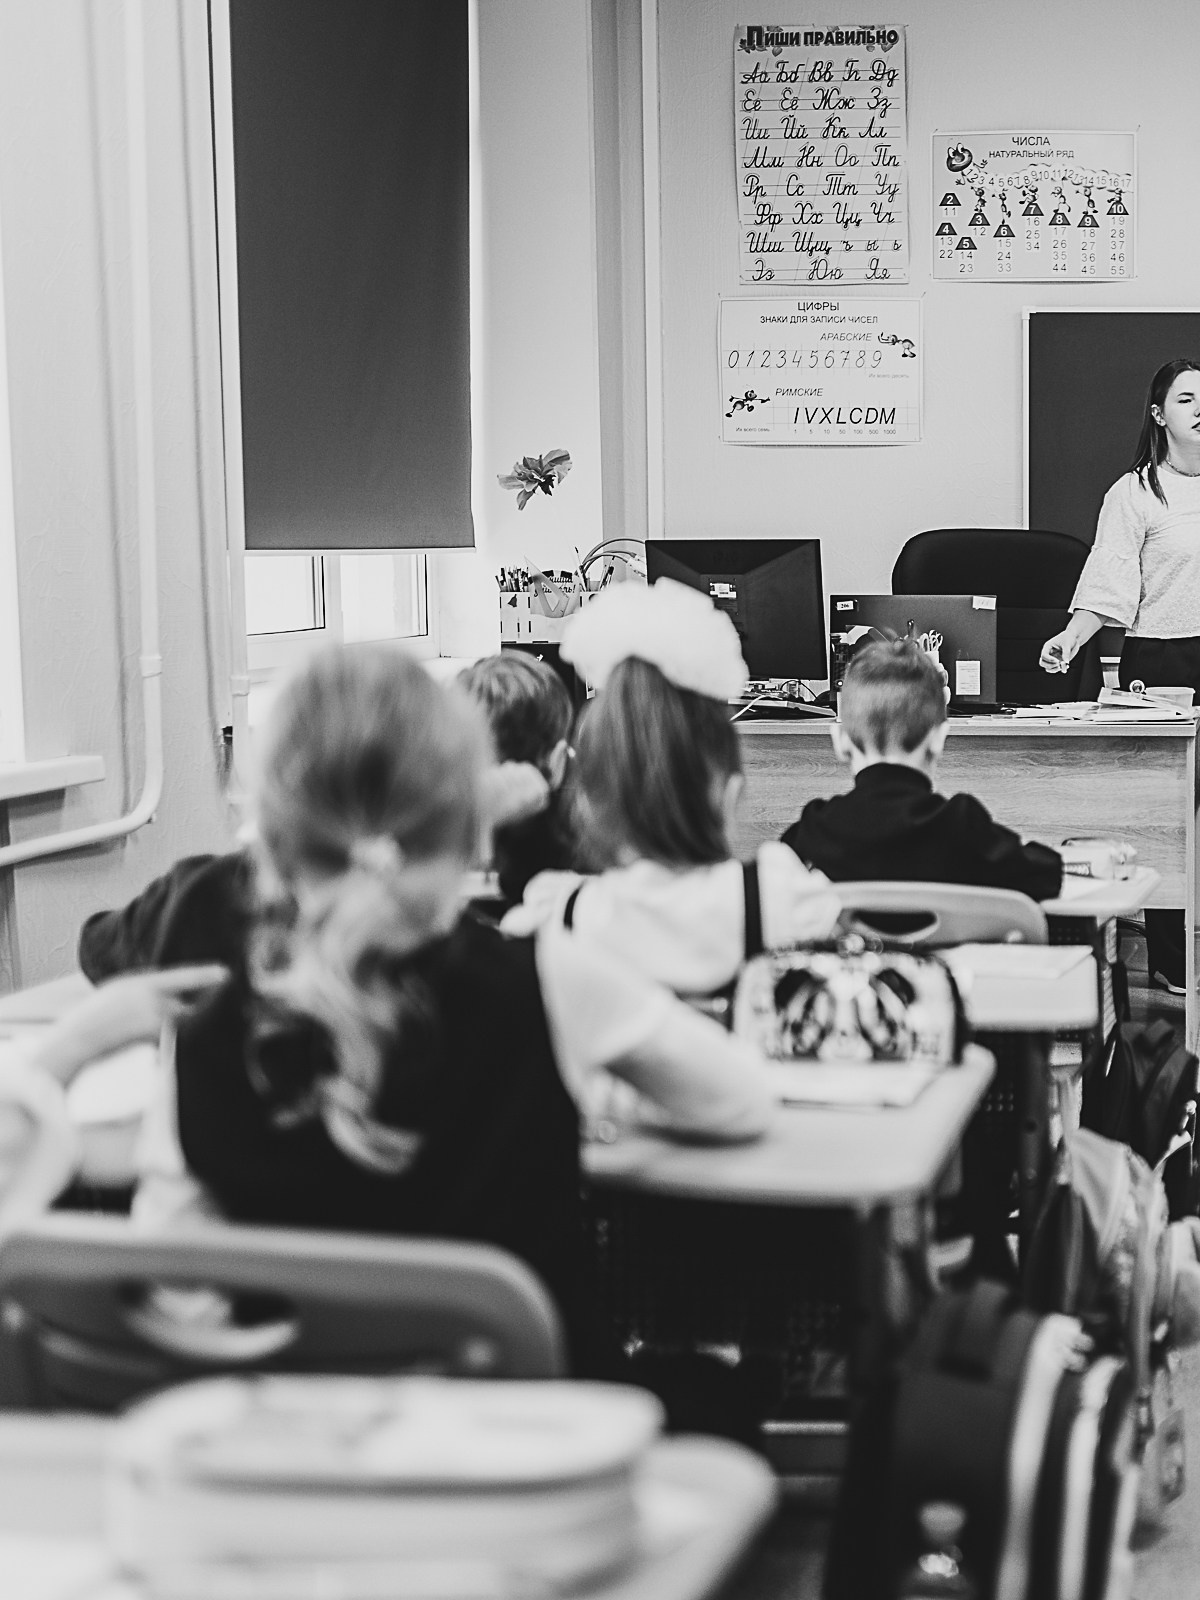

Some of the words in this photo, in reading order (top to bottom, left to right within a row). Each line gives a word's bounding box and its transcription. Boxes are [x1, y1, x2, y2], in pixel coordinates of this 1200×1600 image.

[803, 29, 899, 46] ПРАВИЛЬНО
[1012, 136, 1050, 146] ЧИСЛА
[989, 149, 1054, 158] НАТУРАЛЬНЫЙ
[1056, 150, 1075, 159] РЯД
[978, 175, 985, 185] 3
[989, 177, 995, 186] 4
[999, 178, 1005, 187] 5
[1007, 177, 1013, 186] 6
[1024, 175, 1030, 185] 8
[1031, 170, 1037, 180] 9
[1039, 170, 1050, 180] 10
[1084, 176, 1094, 186] 14
[1097, 176, 1107, 186] 15
[1109, 177, 1119, 187] 16
[1121, 178, 1131, 187] 17
[947, 195, 954, 204] 2
[1029, 205, 1036, 214] 7
[975, 215, 982, 224] 3
[1056, 215, 1063, 224] 8
[1085, 217, 1092, 226] 9
[943, 225, 949, 234] 4
[1001, 227, 1007, 235] 6
[962, 239, 970, 248] 5
[797, 302, 840, 312] ЦИФРЫ
[760, 315, 788, 324] ЗНАКИ
[790, 315, 808, 325] ДЛЯ
[810, 315, 846, 324] ЗАПИСИ
[848, 315, 878, 324] ЧИСЕЛ
[819, 332, 873, 341] АРАБСКИЕ
[775, 388, 824, 397] РИМСКИЕ
